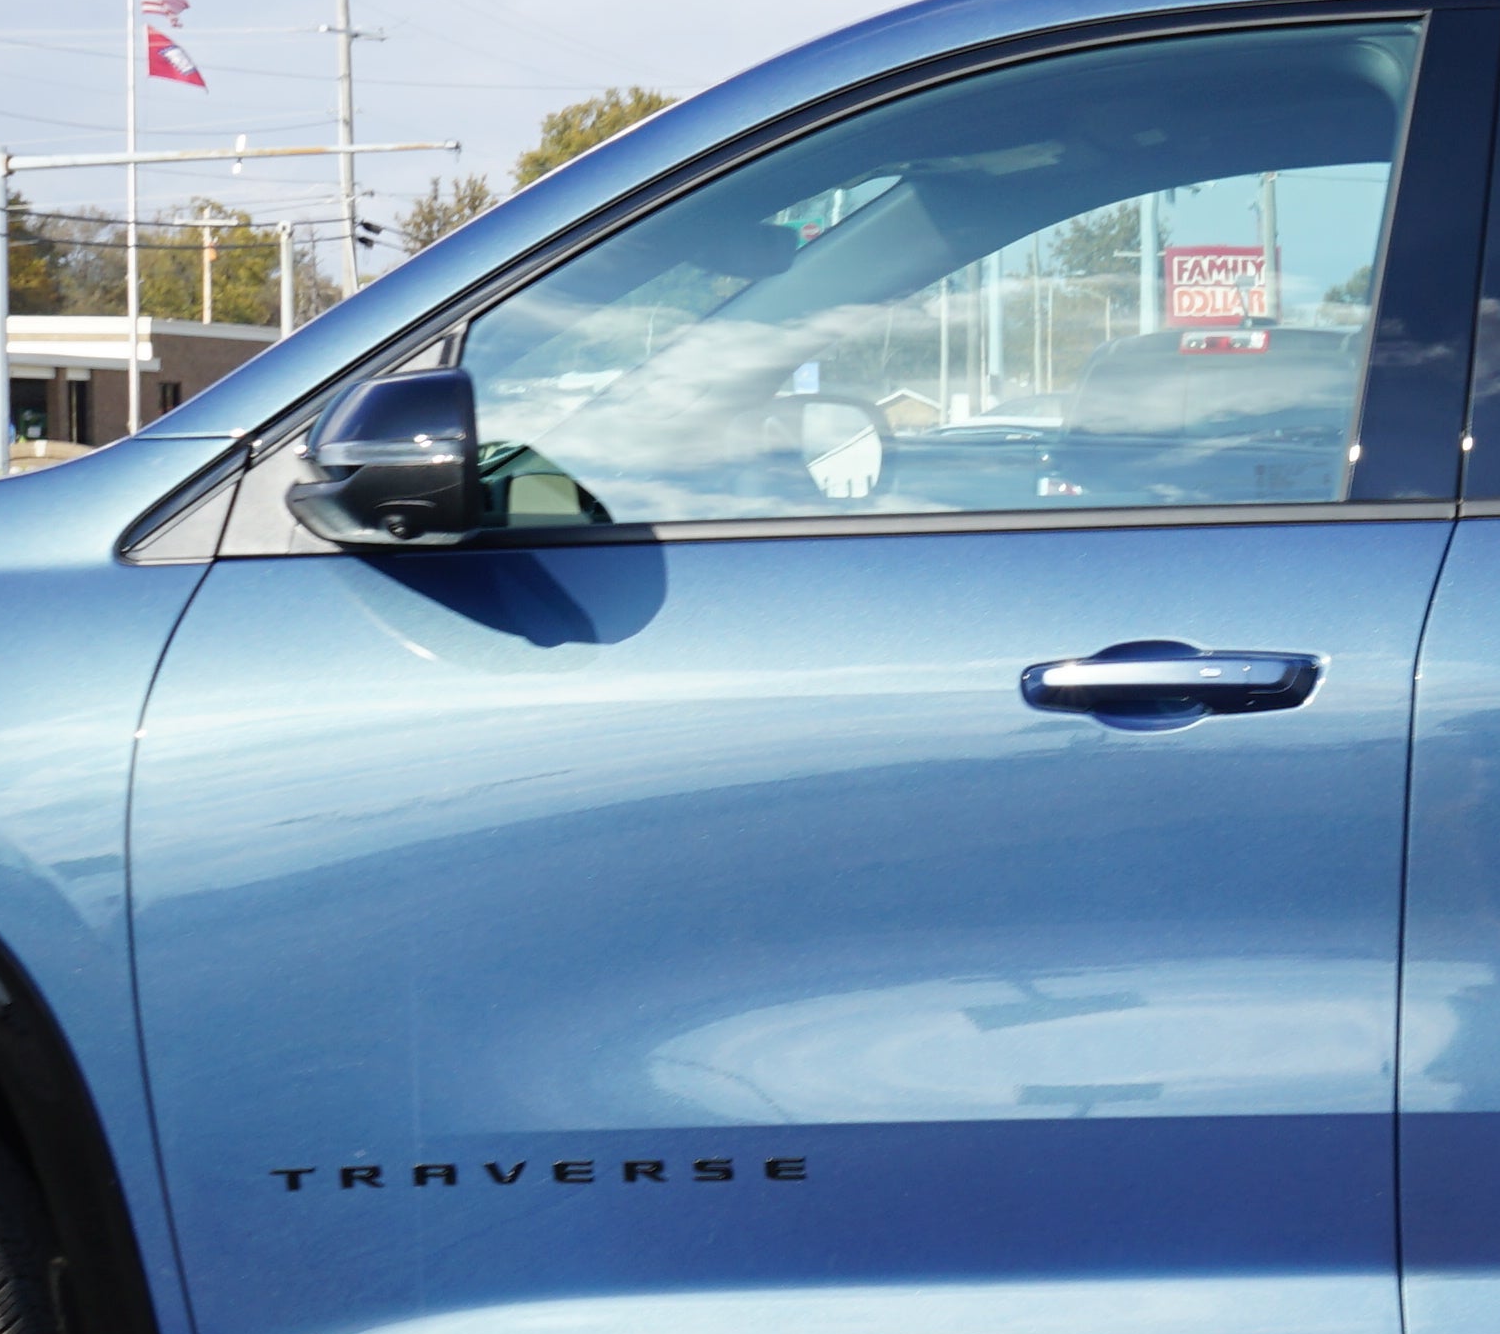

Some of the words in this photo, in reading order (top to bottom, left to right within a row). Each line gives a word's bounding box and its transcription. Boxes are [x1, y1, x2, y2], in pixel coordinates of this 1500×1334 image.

[1172, 255, 1267, 286] FAMILY
[1173, 286, 1268, 317] DOLLAR
[268, 1155, 808, 1193] TRAVERSE
